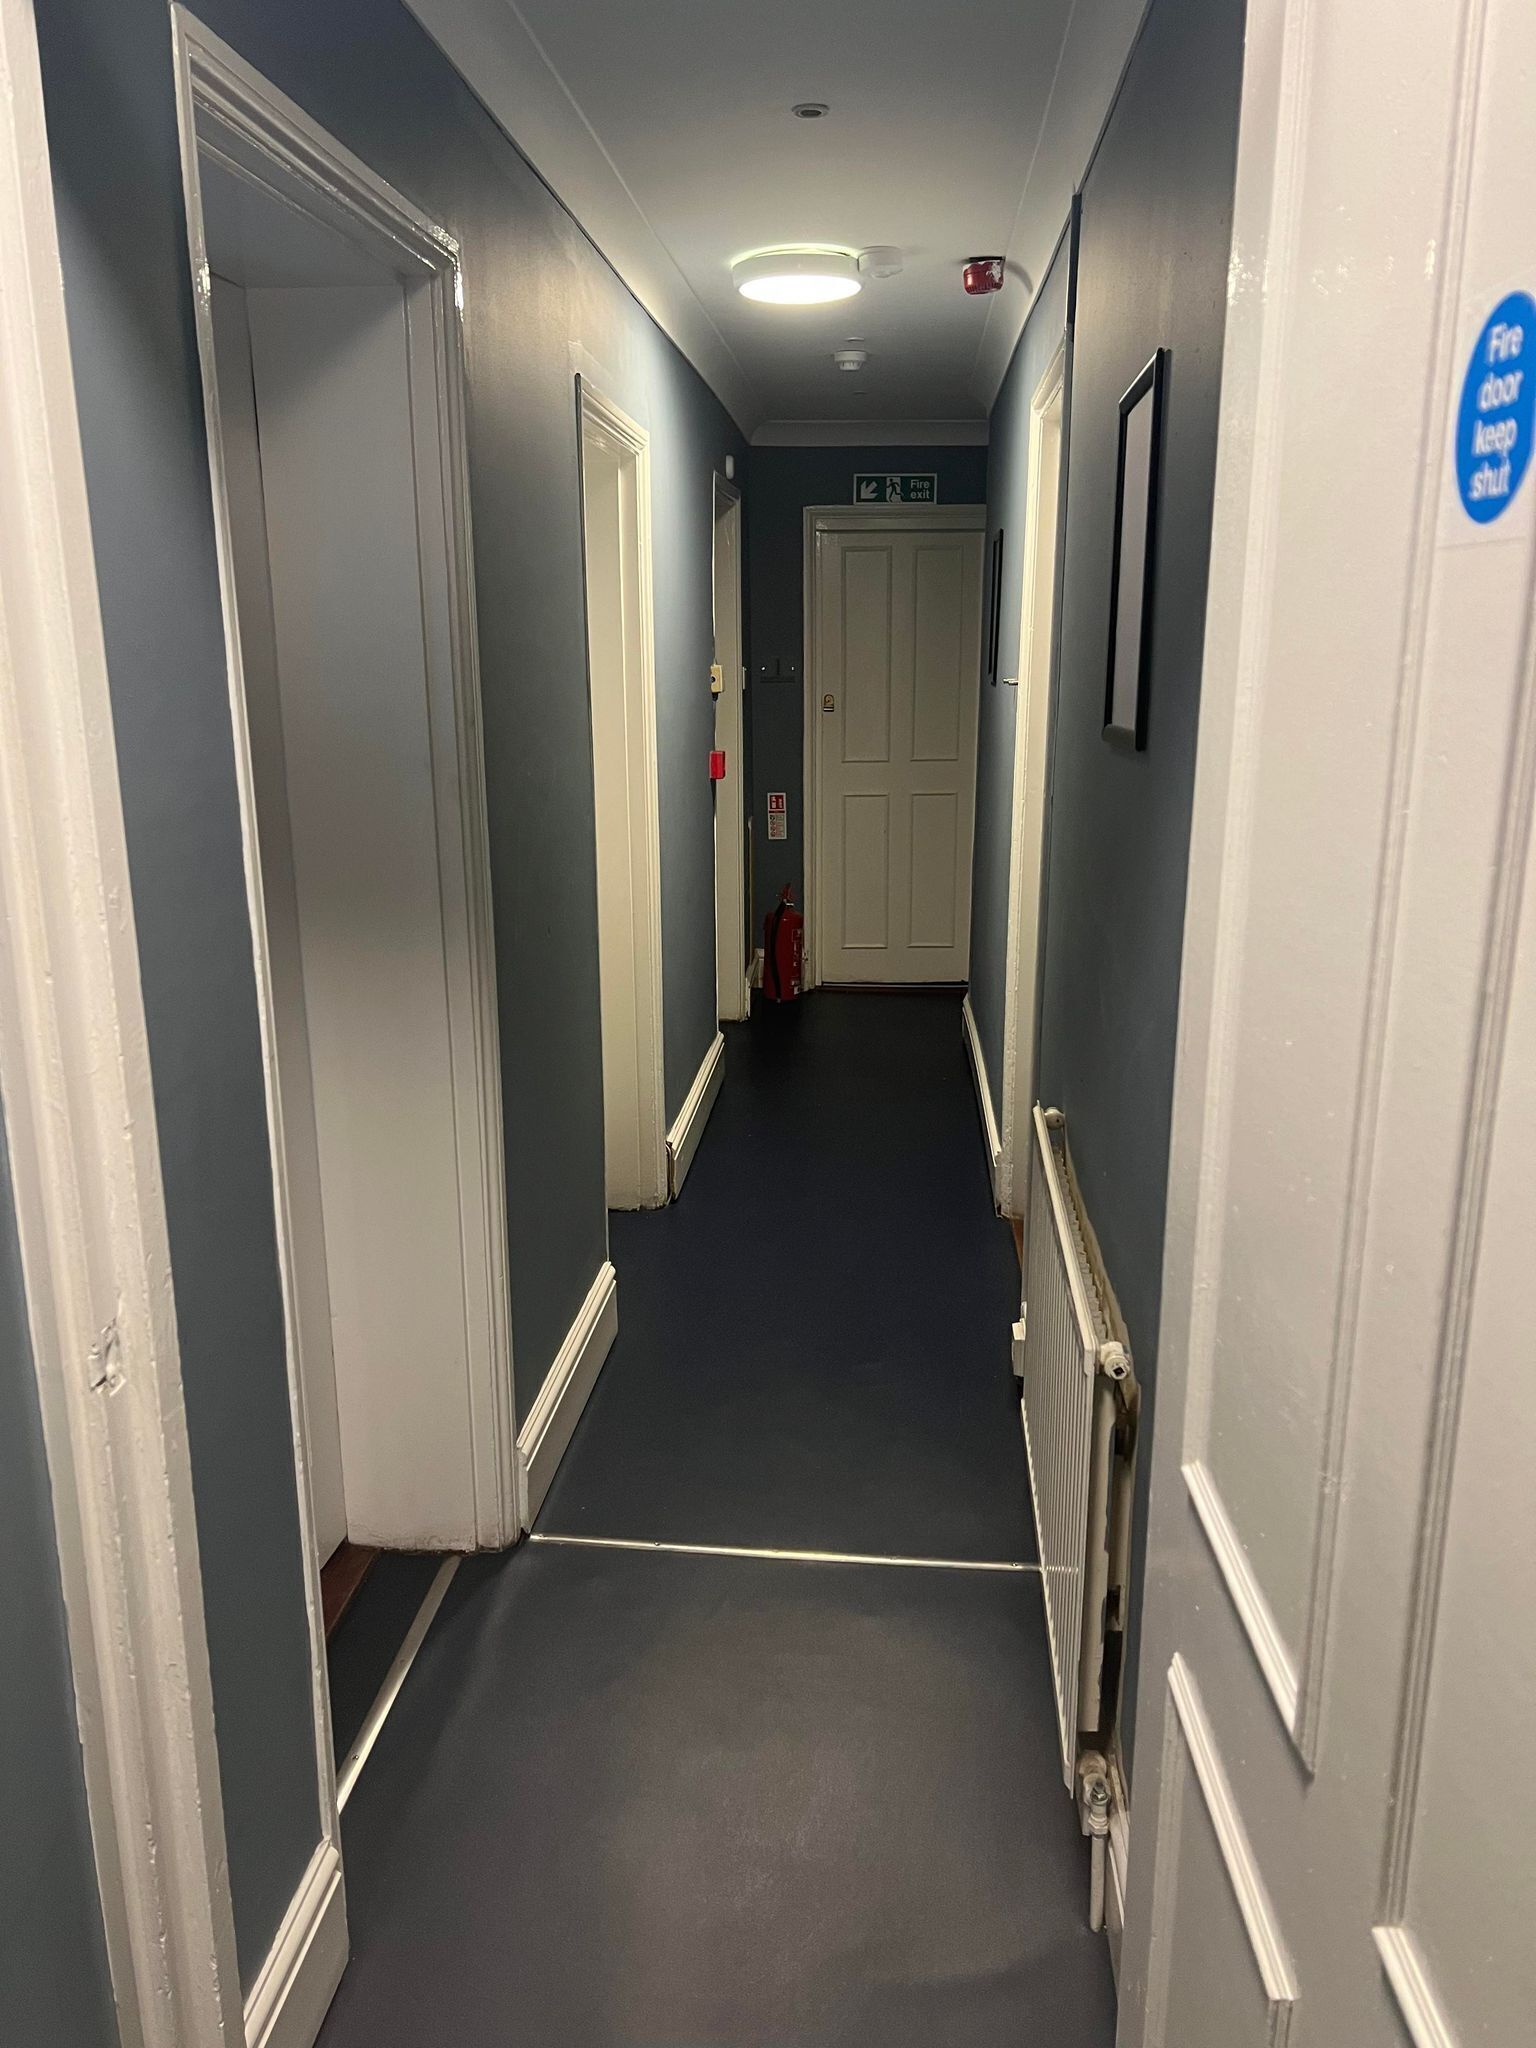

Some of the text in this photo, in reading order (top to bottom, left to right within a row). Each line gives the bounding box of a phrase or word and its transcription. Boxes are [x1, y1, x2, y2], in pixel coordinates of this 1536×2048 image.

[1487, 322, 1523, 364] Fire
[1479, 370, 1523, 410] door
[1473, 417, 1517, 459] keep
[910, 479, 930, 489] Fire
[910, 489, 930, 499] exit
[1470, 461, 1511, 500] shut
